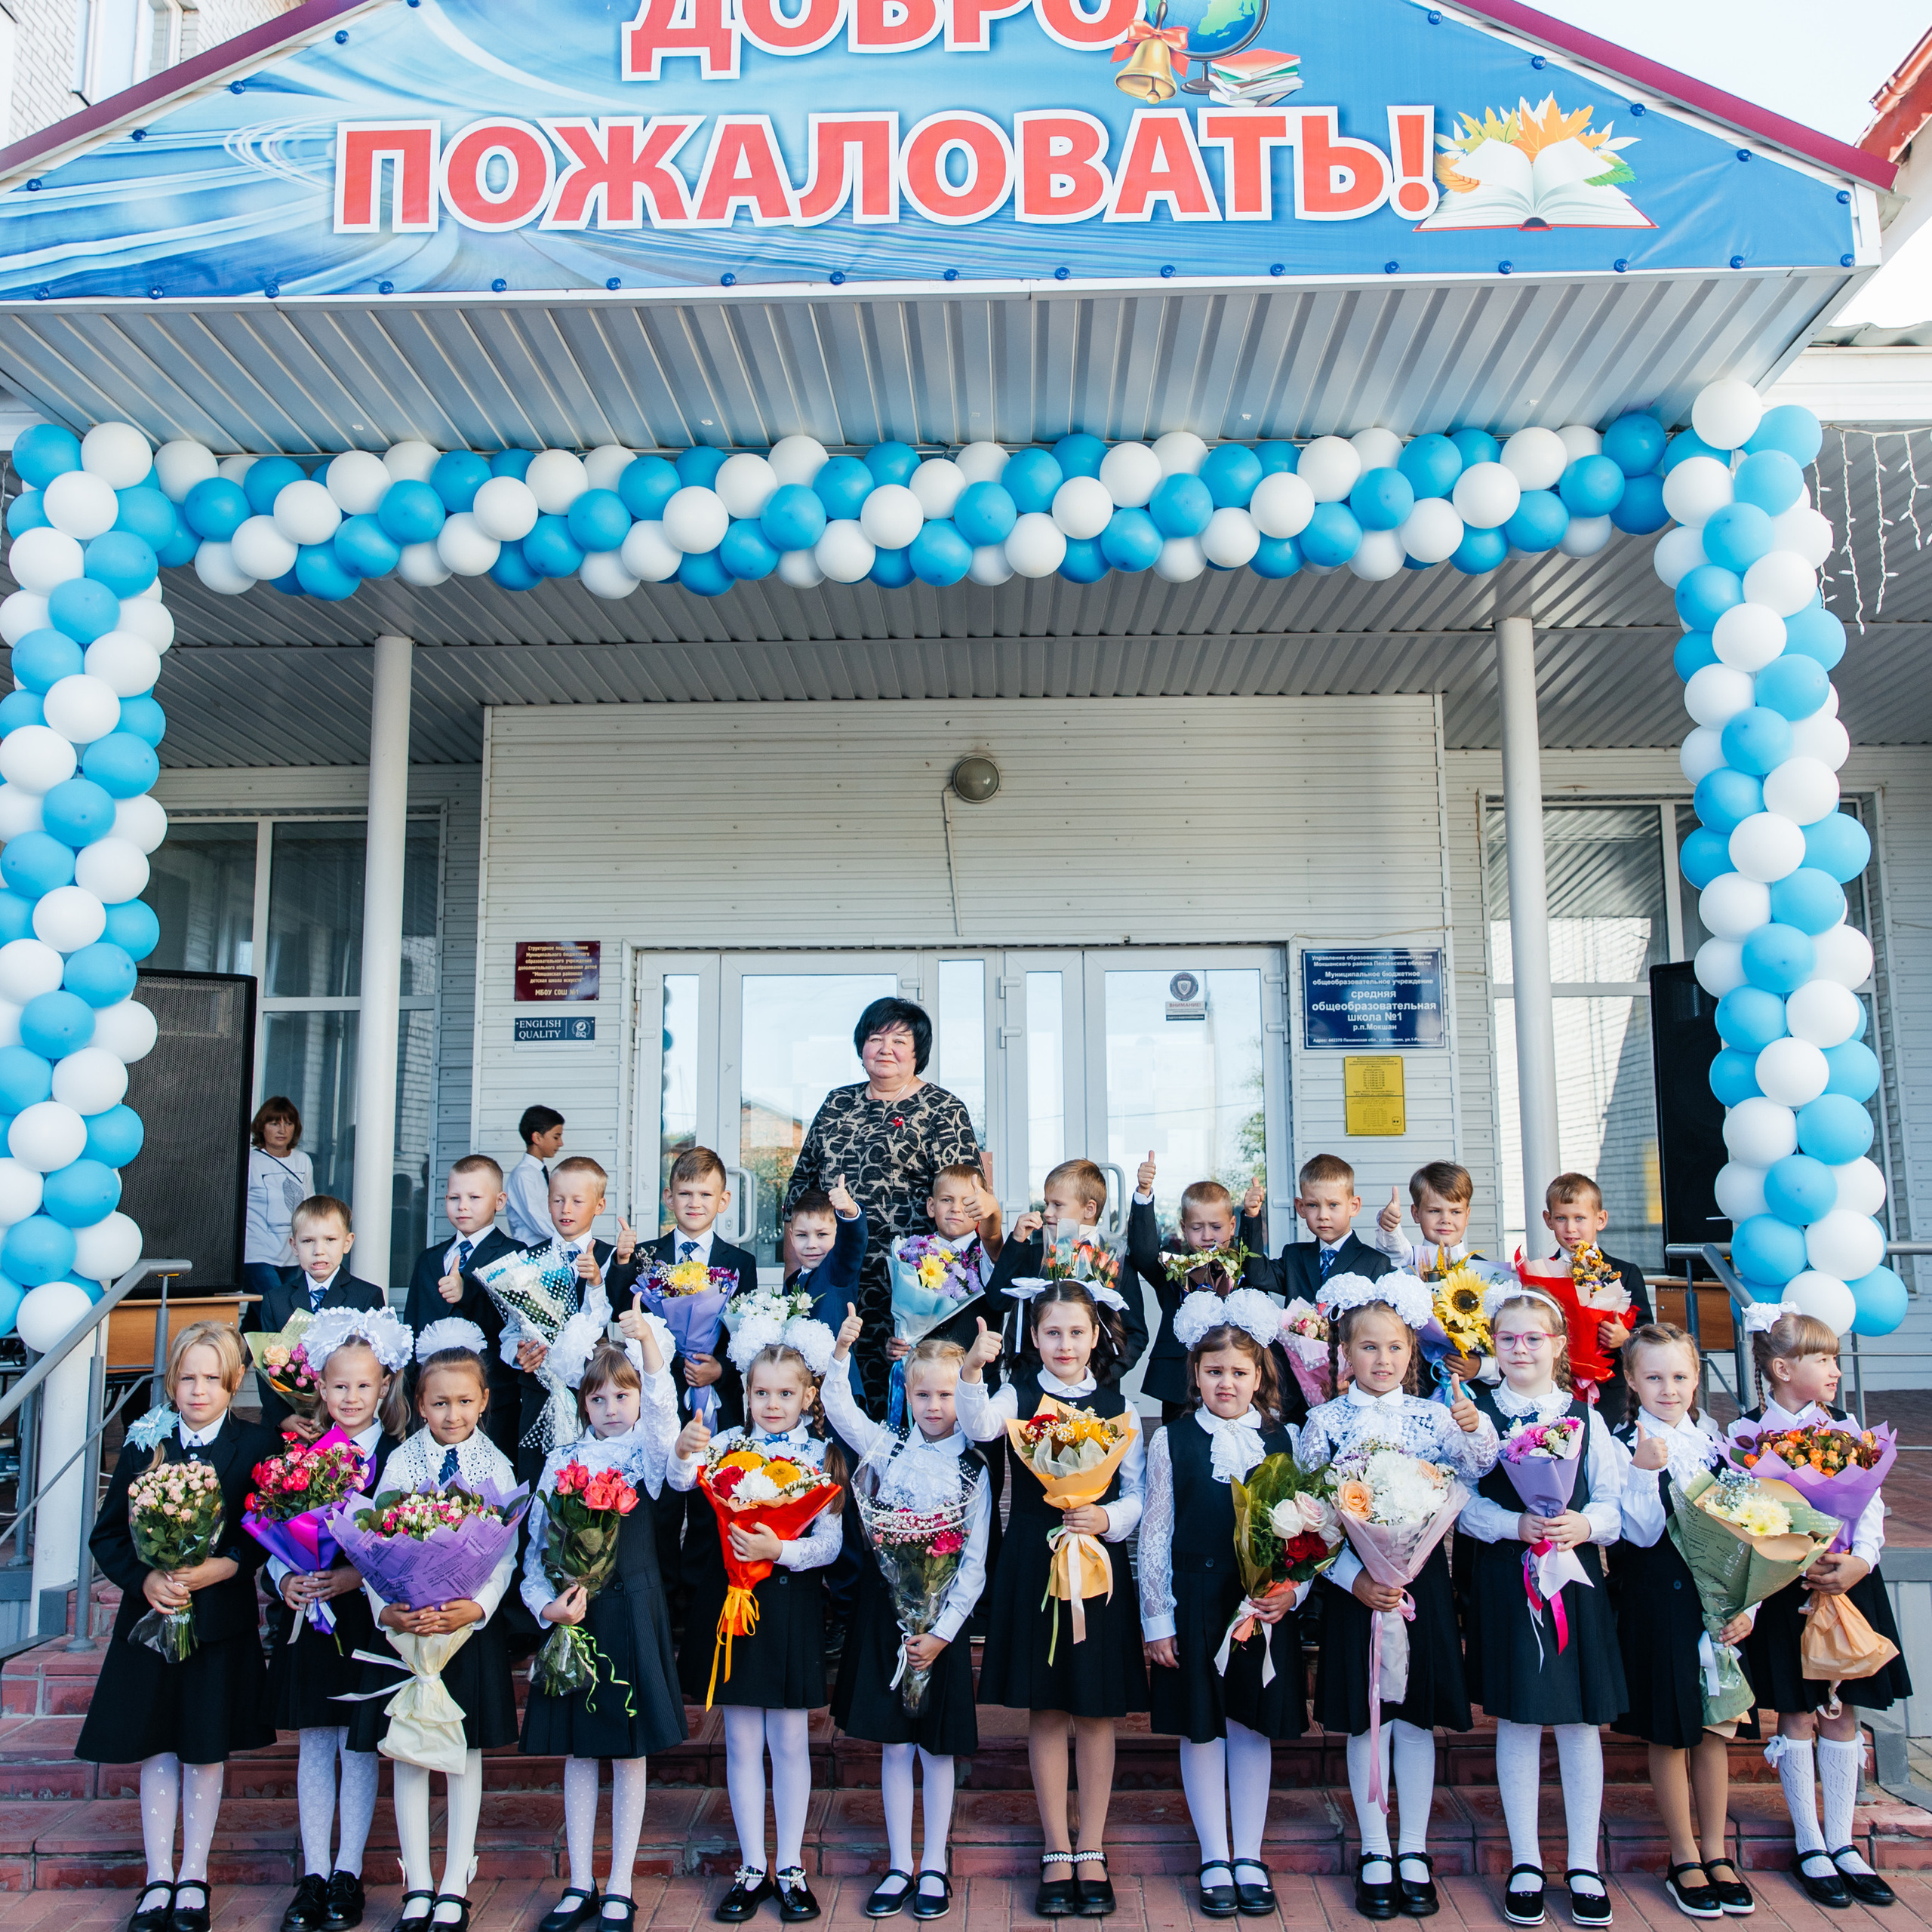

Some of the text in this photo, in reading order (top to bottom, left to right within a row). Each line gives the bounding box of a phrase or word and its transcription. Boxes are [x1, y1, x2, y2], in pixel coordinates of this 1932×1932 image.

[334, 106, 1440, 233] ПОЖАЛОВАТЬ!
[1352, 990, 1396, 999] средняя
[1312, 1002, 1436, 1012] общеобразовательная
[1385, 1012, 1402, 1021] №1
[1353, 1023, 1397, 1032] р.п.Мокшан
[518, 1030, 561, 1040] QUALITY
